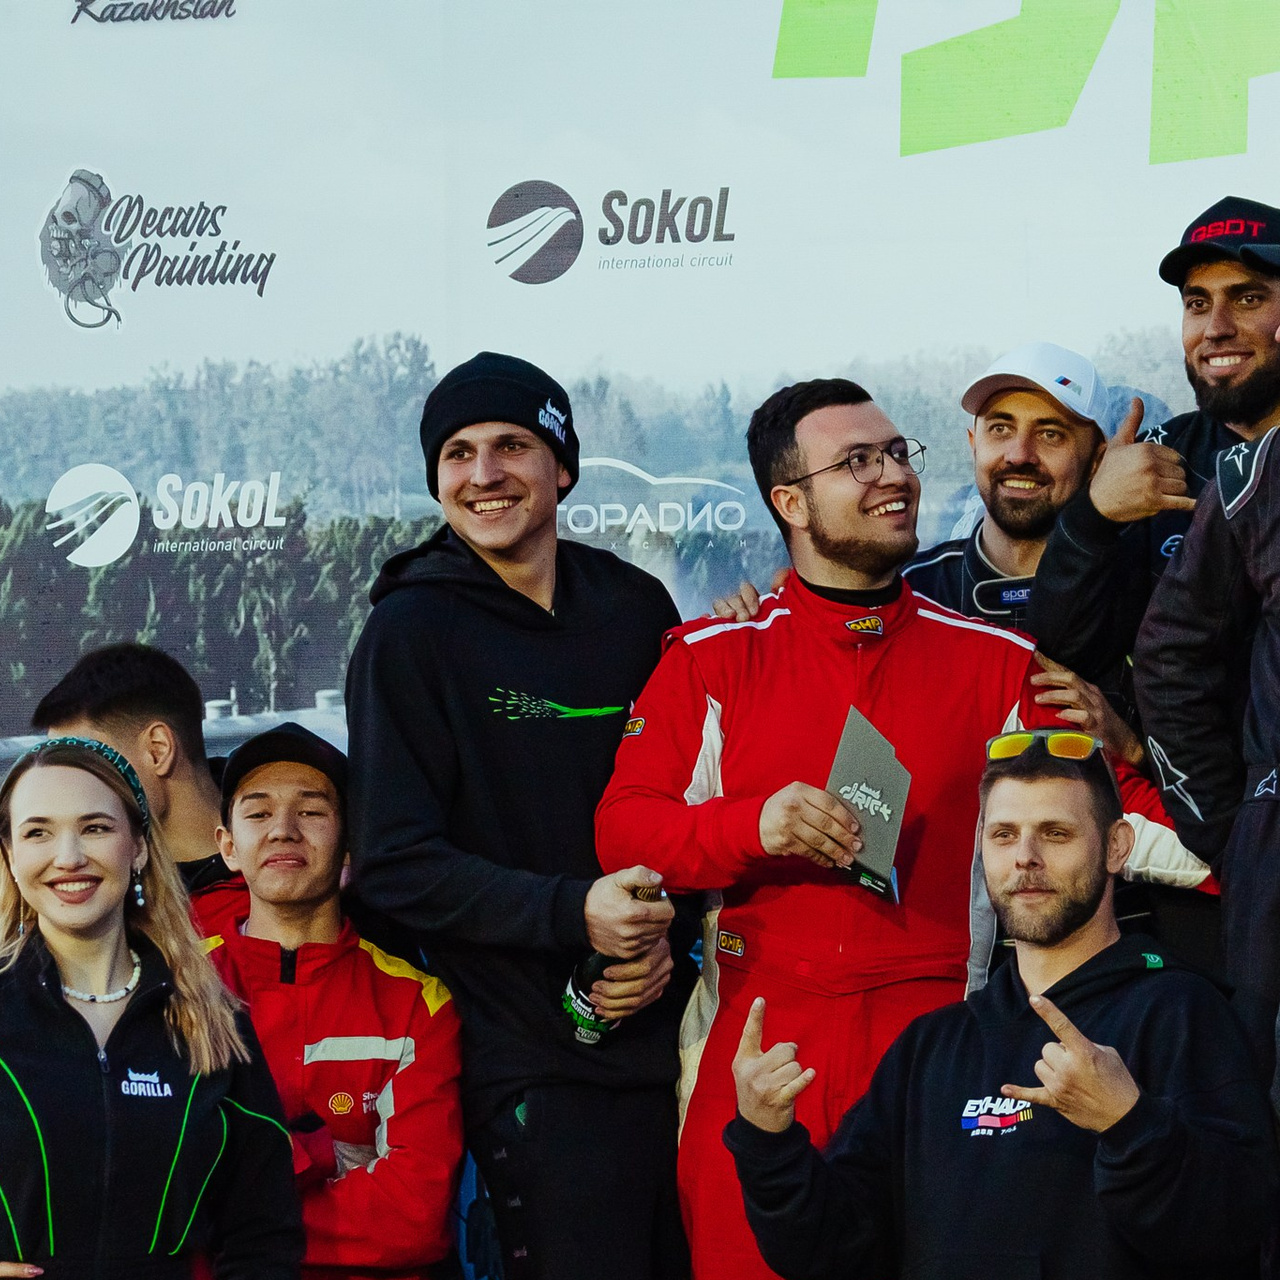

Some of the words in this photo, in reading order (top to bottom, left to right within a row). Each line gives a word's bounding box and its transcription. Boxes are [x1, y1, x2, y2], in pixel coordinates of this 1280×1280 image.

[104, 194, 227, 245] Decars
[122, 241, 276, 298] Painting
[598, 253, 685, 270] international
[689, 252, 733, 267] circuit
[153, 538, 238, 553] international
[242, 536, 284, 550] circuit
[571, 998, 596, 1021] GORILLA
[121, 1080, 173, 1097] GORILLA
